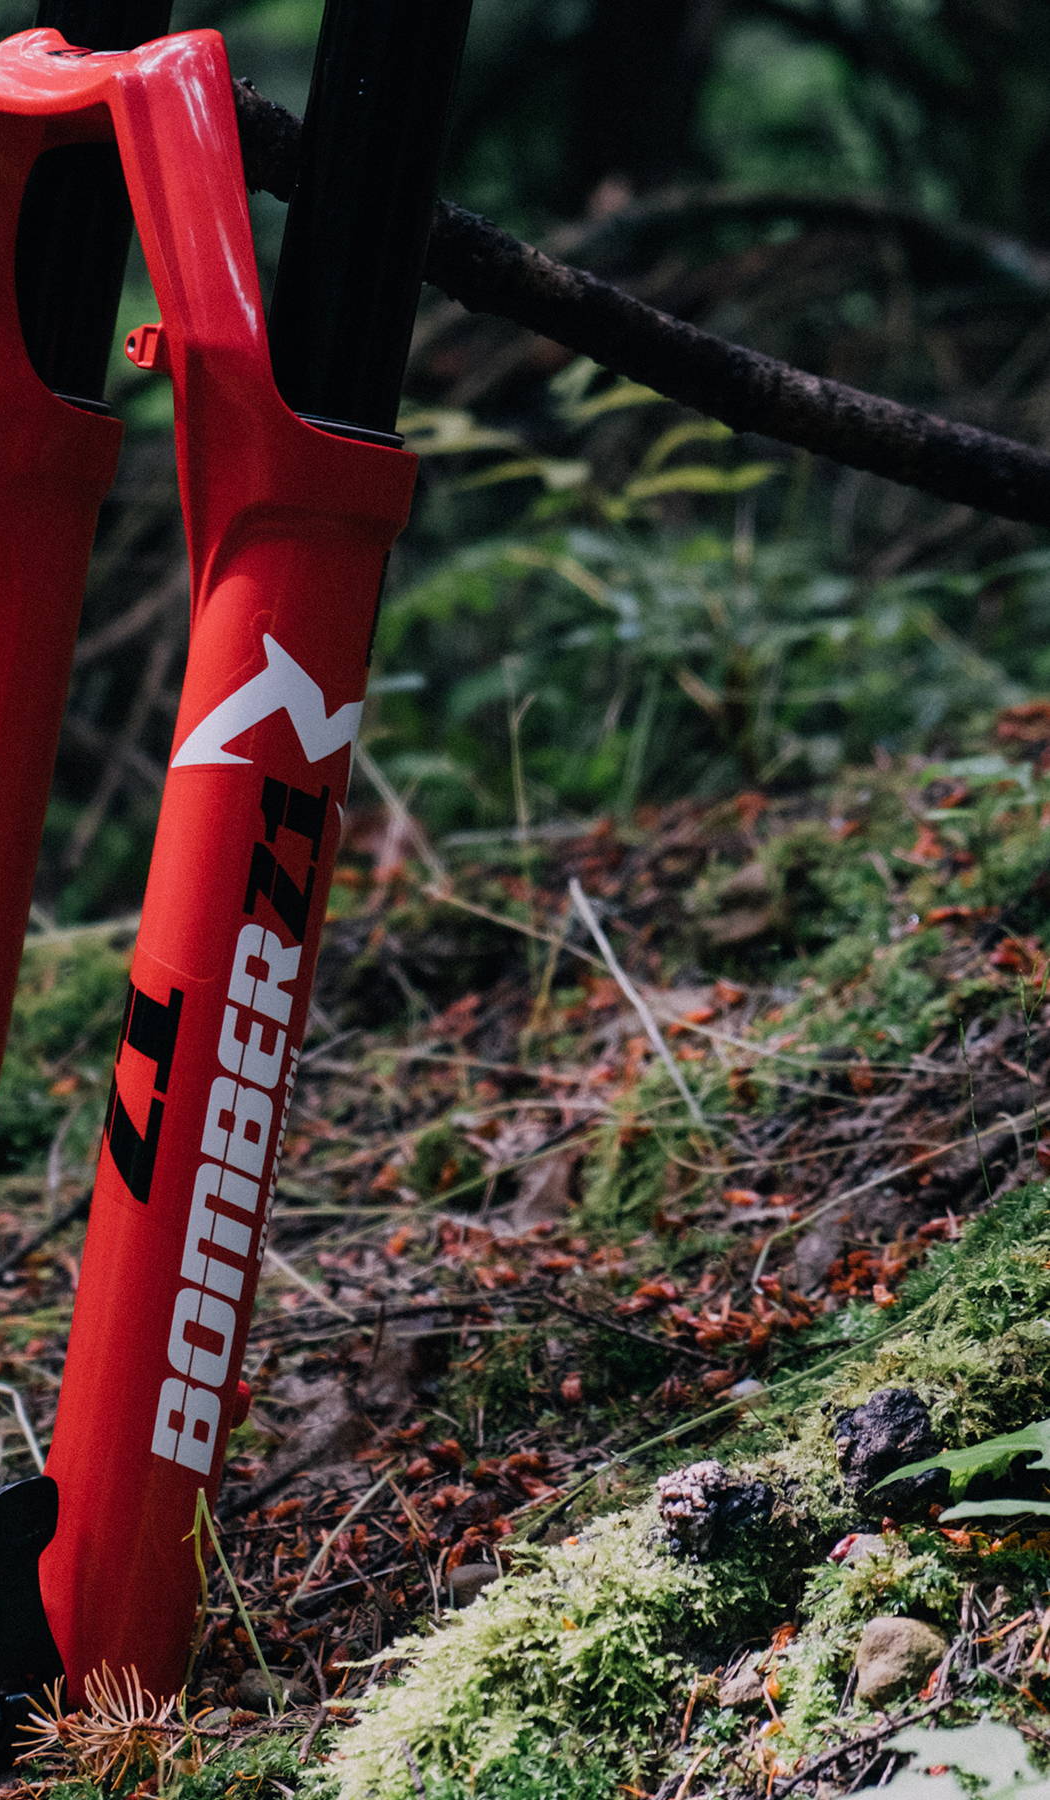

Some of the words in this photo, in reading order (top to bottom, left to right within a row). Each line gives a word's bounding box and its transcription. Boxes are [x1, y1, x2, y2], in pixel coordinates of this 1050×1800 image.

[105, 978, 185, 1204] Z1
[151, 923, 302, 1475] BOMBER
[244, 776, 330, 943] Z1
